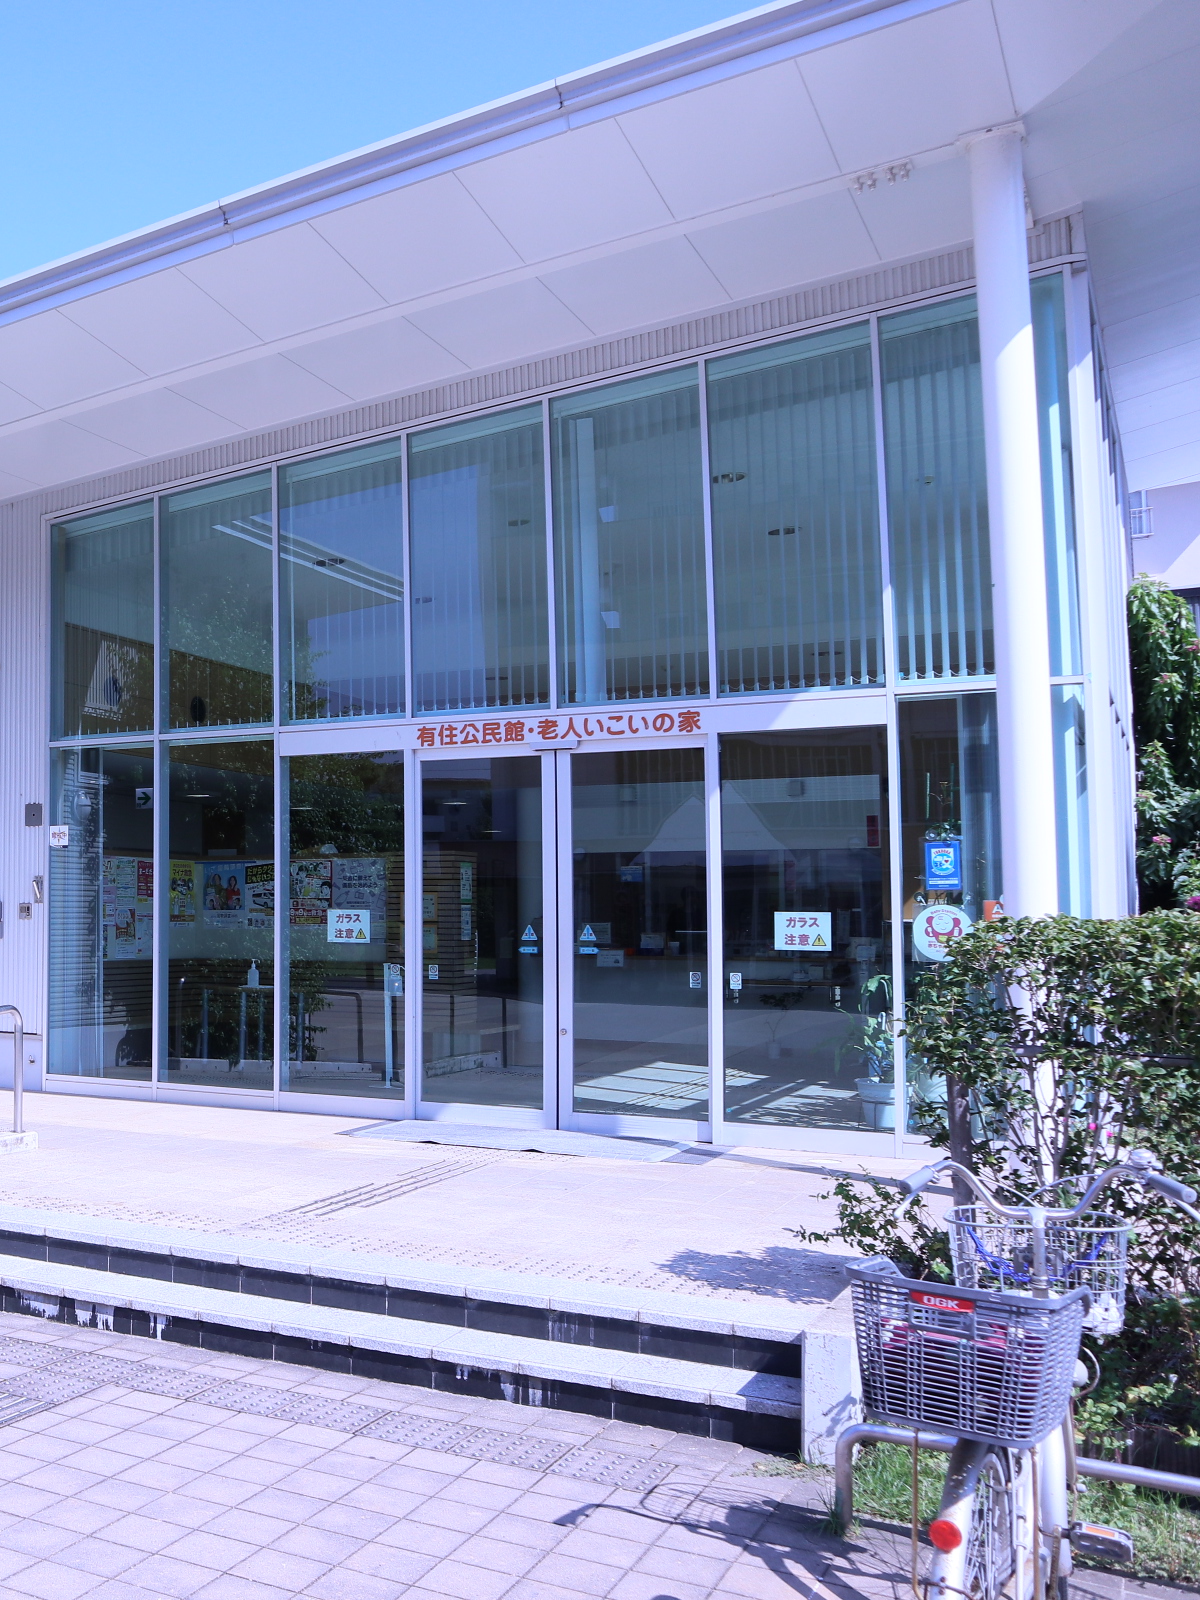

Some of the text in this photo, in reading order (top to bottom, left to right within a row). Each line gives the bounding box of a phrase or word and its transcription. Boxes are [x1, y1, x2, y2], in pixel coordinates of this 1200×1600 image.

[416, 710, 702, 747] 有住公民館・老人いこいの家
[336, 914, 361, 923] ガラス
[786, 917, 820, 928] ガラス
[335, 928, 354, 939] 注意
[784, 934, 810, 946] 注意
[923, 1296, 959, 1309] OGK
